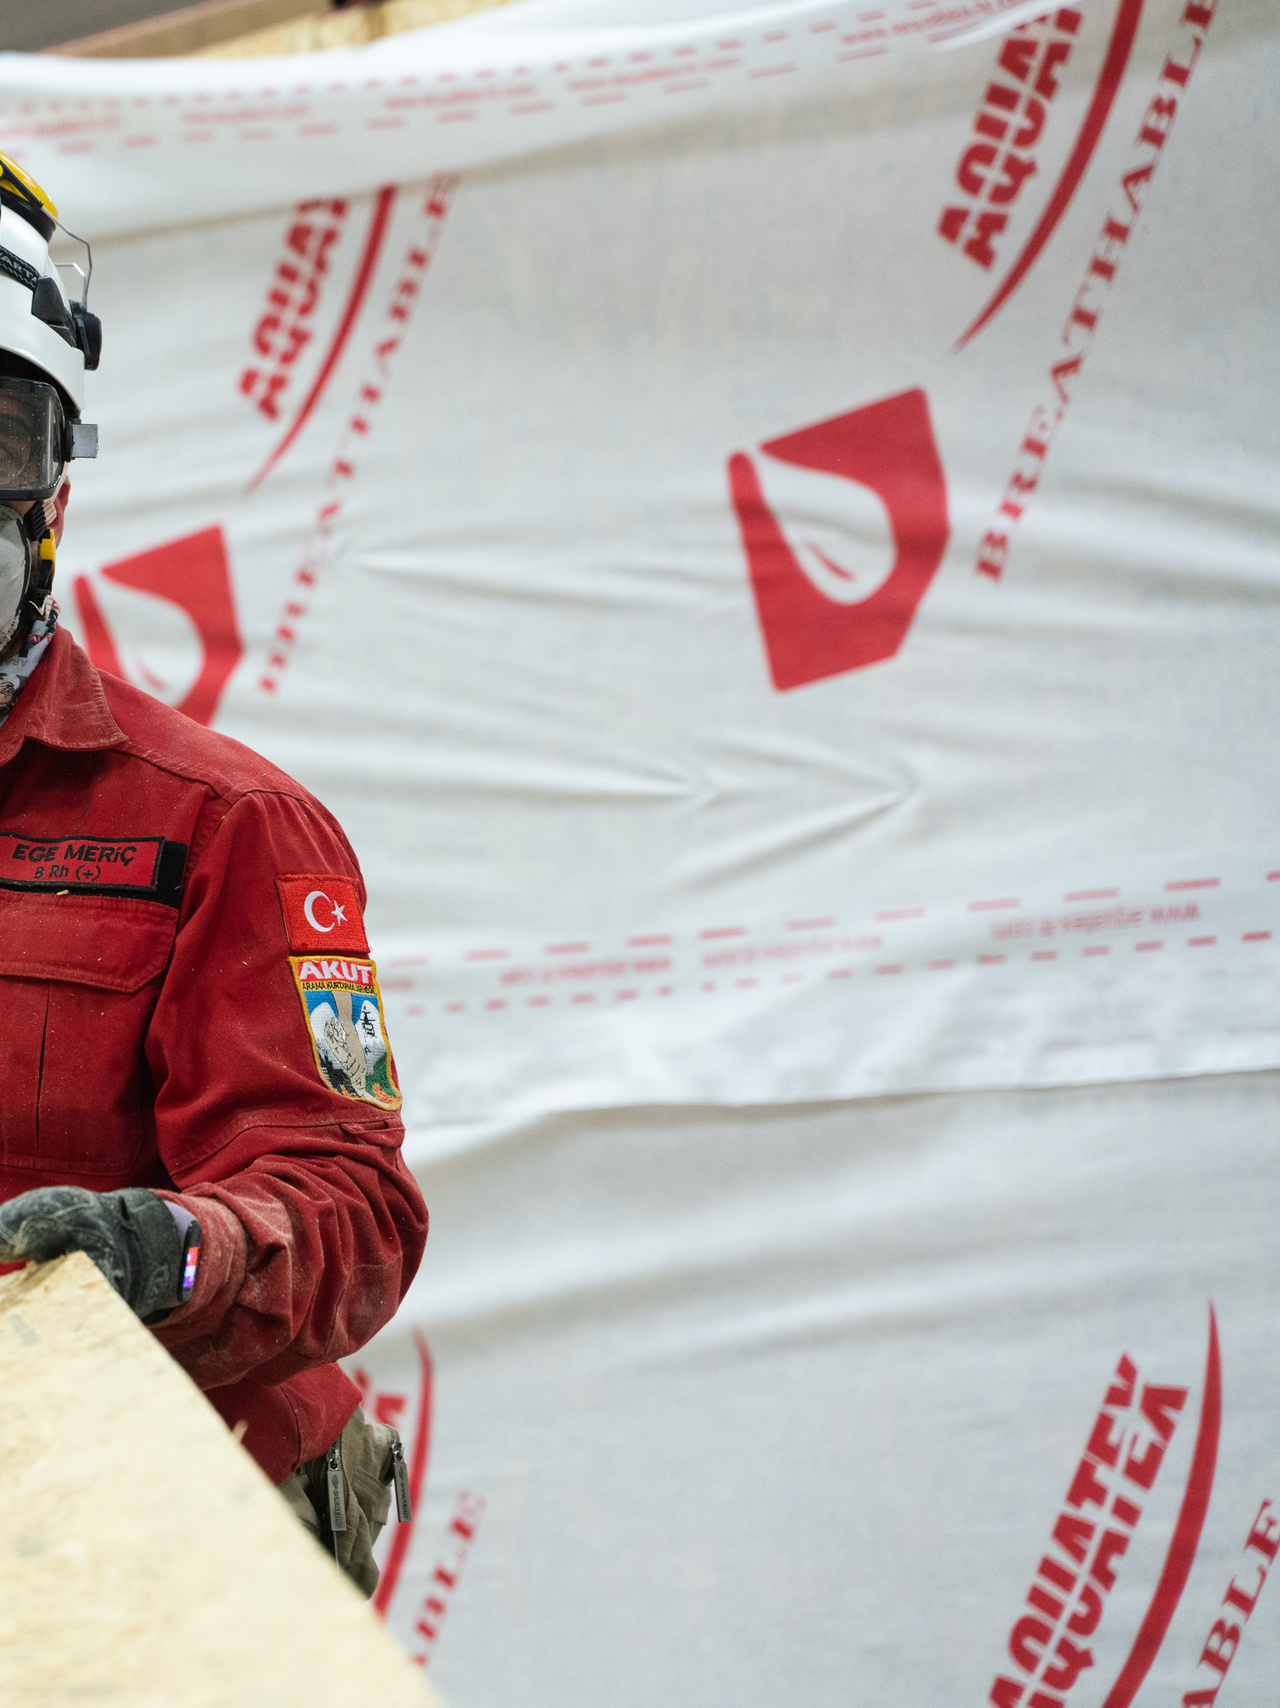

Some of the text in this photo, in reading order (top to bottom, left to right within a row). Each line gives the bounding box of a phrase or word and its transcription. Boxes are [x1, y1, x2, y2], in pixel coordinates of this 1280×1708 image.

[12, 843, 60, 862] EGE
[49, 864, 70, 878] Rh
[300, 960, 373, 984] AKUT
